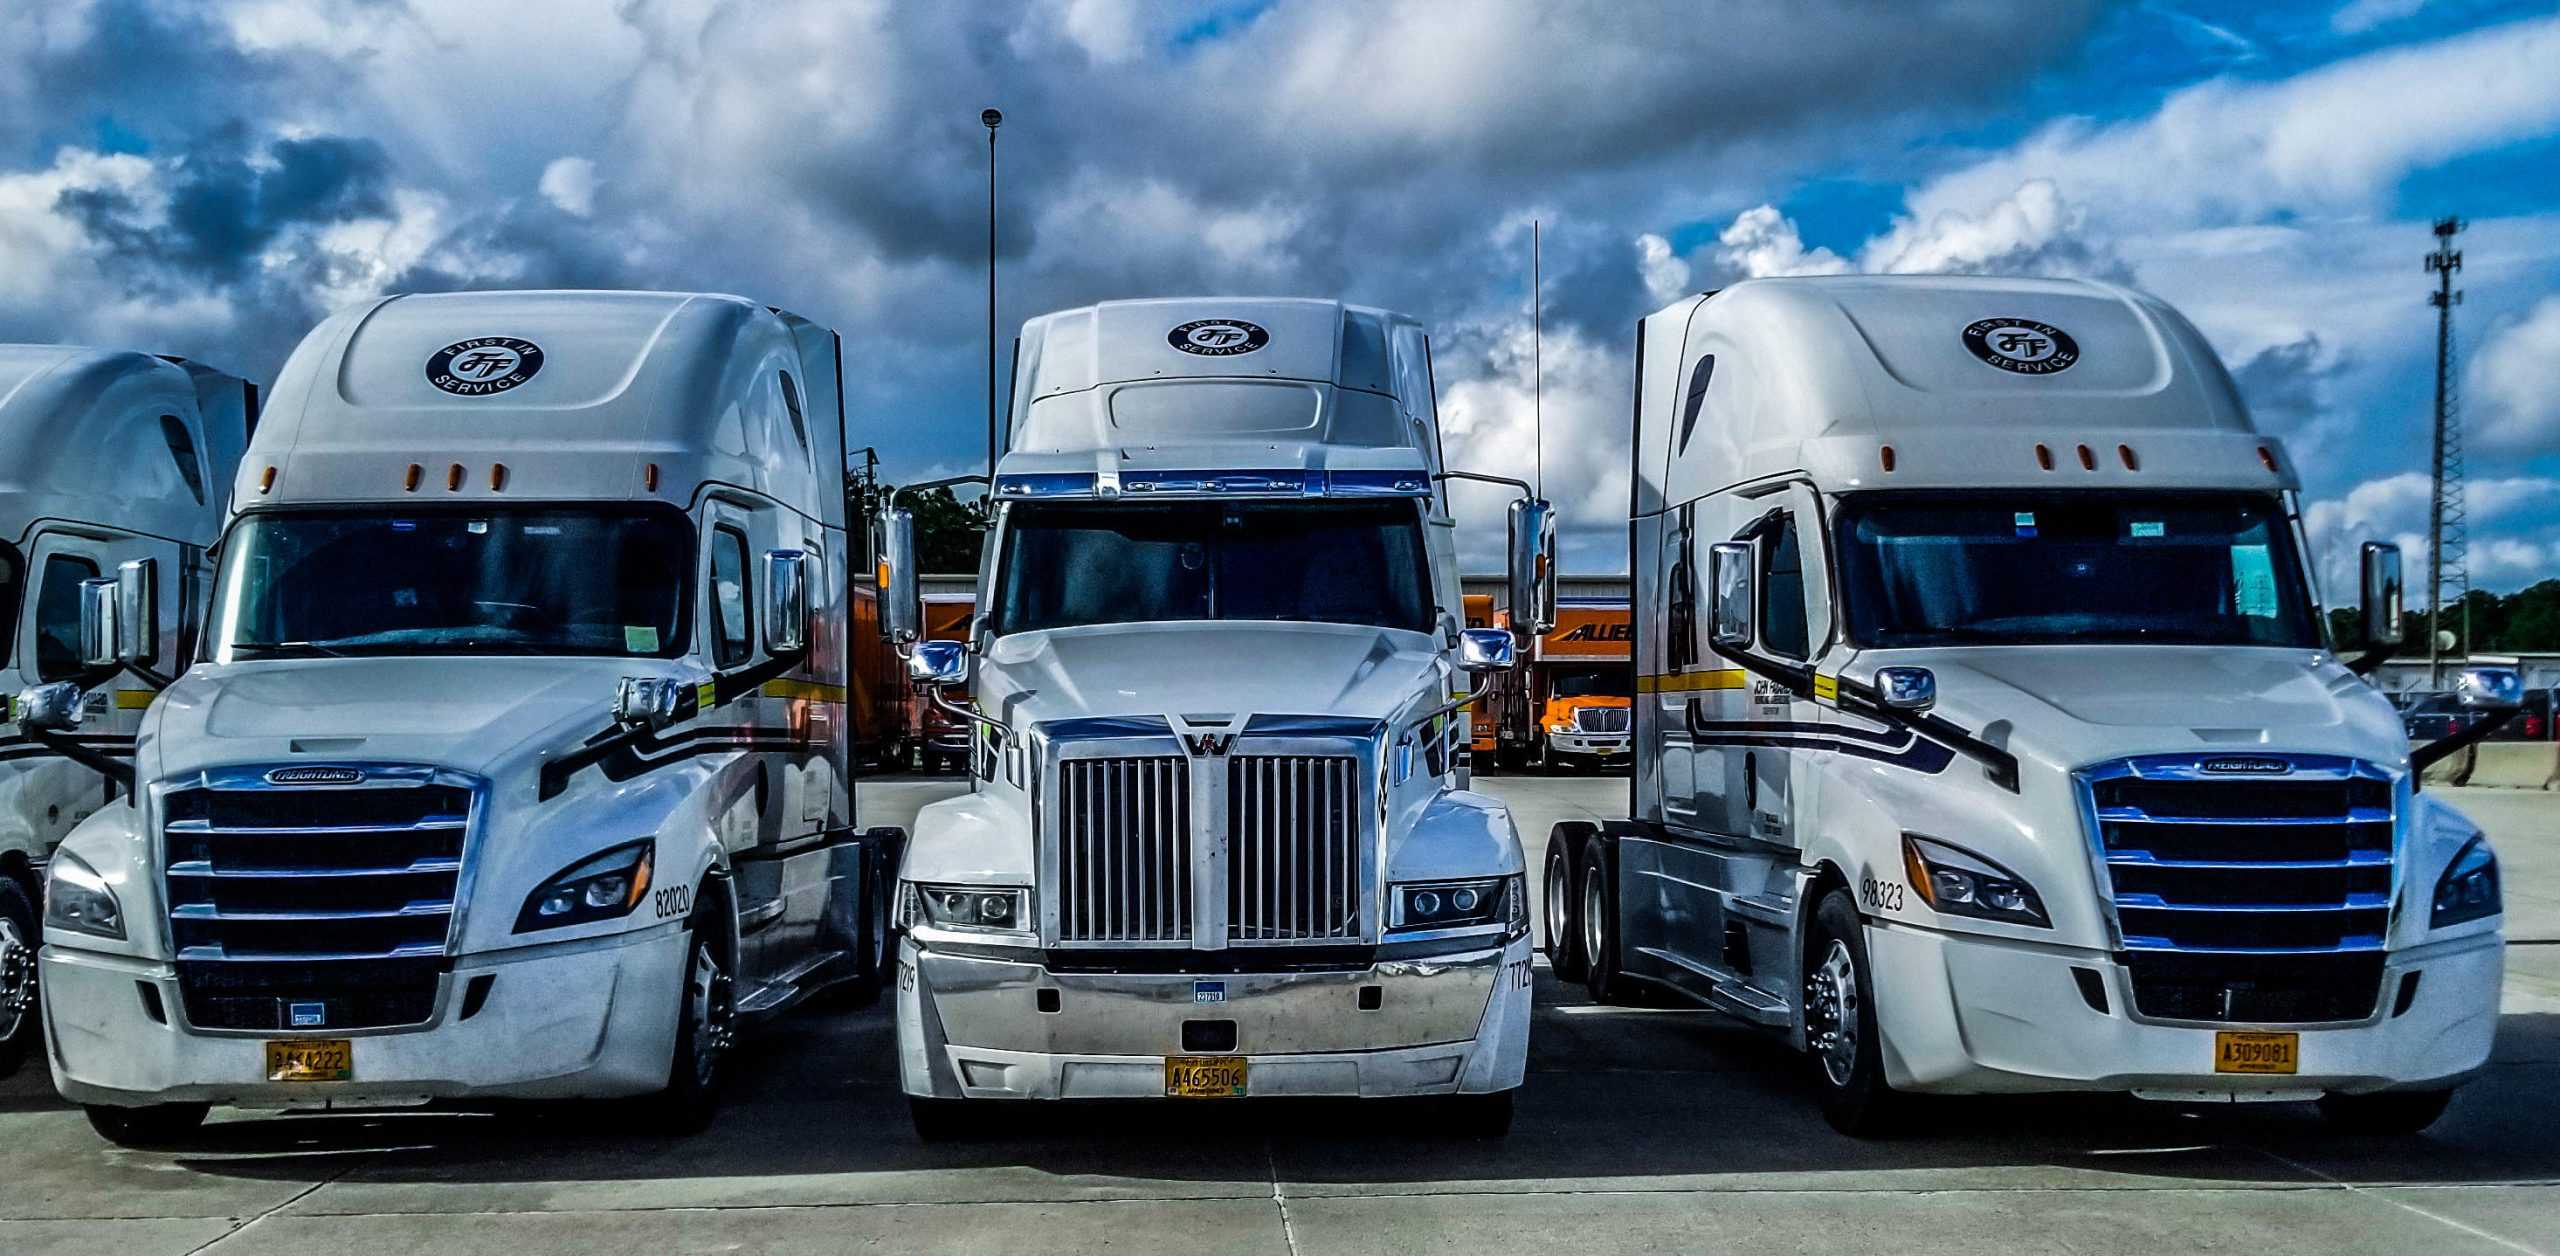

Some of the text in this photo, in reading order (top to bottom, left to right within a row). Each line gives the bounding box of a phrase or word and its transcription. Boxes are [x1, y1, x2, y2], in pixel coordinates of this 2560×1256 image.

[1178, 320, 1259, 332] FIRST IN
[1968, 320, 2057, 337] FIRST IN
[443, 338, 537, 356] FIRST IN
[1179, 342, 1259, 355] SERVICE
[1987, 351, 2075, 372] SERVICE
[435, 372, 526, 393] SERVICE
[275, 770, 355, 780] FREIGHTLINER
[656, 884, 690, 918] 82020
[1863, 878, 1902, 912] 98323
[2223, 1043, 2289, 1063] A309081
[1173, 1067, 1240, 1087] A465506
